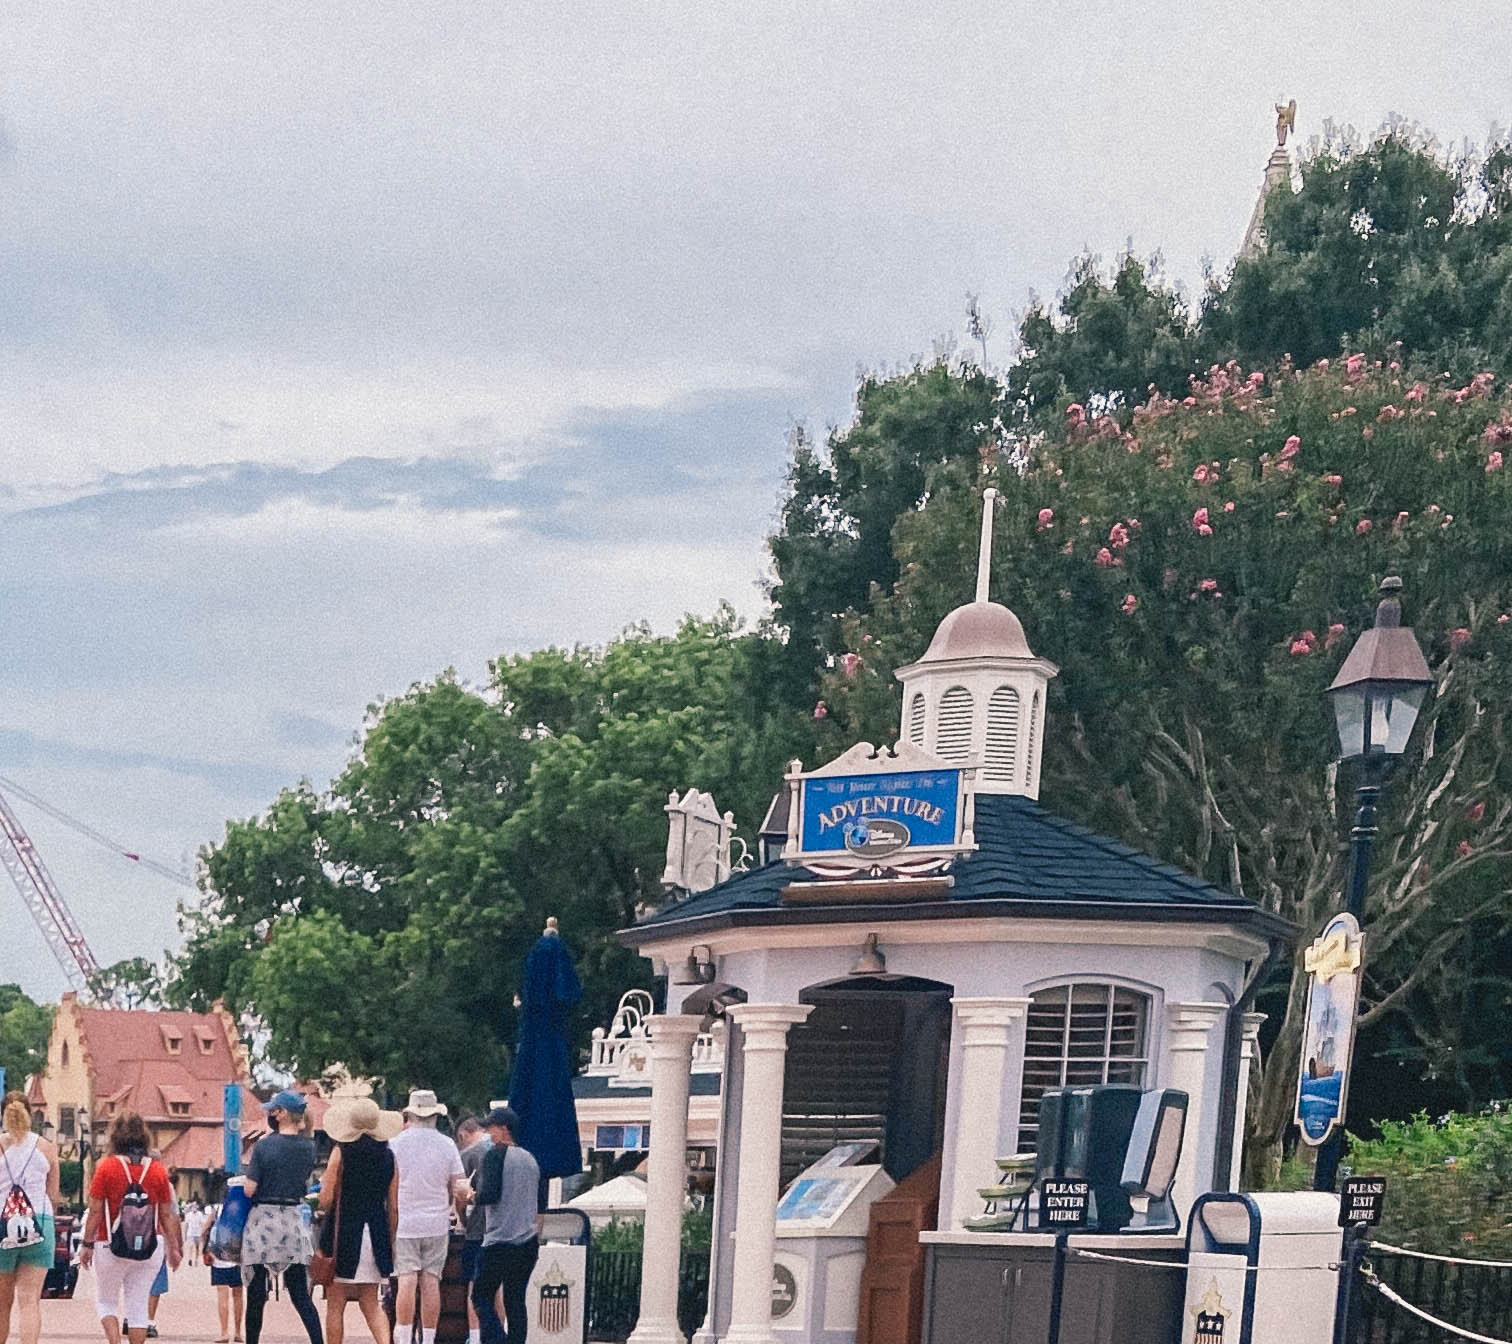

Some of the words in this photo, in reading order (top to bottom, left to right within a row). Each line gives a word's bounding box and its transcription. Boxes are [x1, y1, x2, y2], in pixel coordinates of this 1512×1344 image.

[817, 795, 946, 834] ADVENTURE
[1045, 1183, 1088, 1194] PLEASE
[1347, 1183, 1384, 1194] PLEASE
[1047, 1196, 1084, 1208] ENTER
[1352, 1196, 1375, 1208] EXIT
[1049, 1210, 1080, 1222] HERE
[1347, 1209, 1375, 1221] HERE
